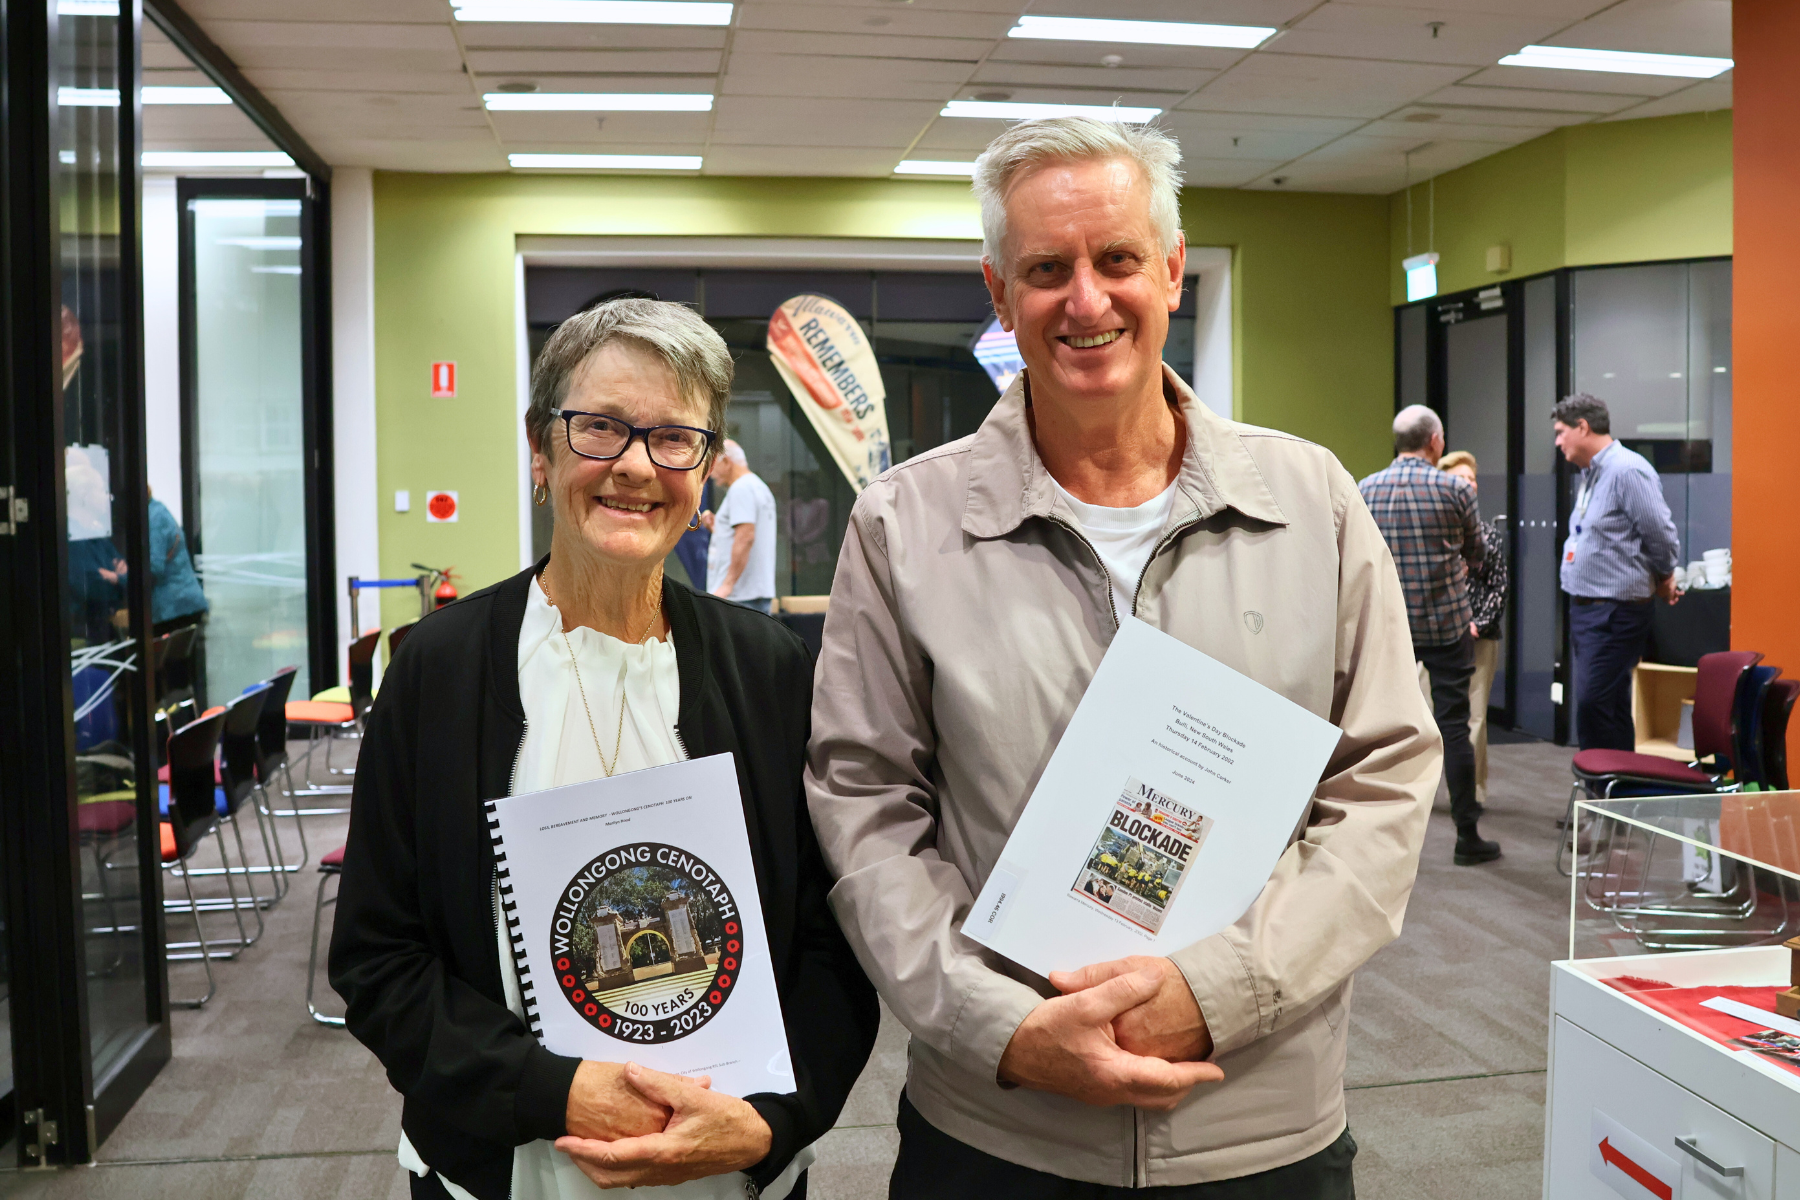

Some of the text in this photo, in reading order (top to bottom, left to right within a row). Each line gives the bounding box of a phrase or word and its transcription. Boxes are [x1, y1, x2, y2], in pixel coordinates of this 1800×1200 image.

[800, 318, 875, 420] REMEMBERS
[1166, 725, 1190, 742] Thursday
[1198, 742, 1221, 758] February
[1172, 705, 1246, 748] The Valentine's Day Blockade
[1190, 726, 1201, 735] New
[1202, 733, 1217, 744] South
[1218, 741, 1233, 753] Wales
[1158, 742, 1180, 756] historical
[1180, 754, 1198, 766] account
[1205, 768, 1216, 776] John
[1137, 784, 1196, 820] MERCURY
[1110, 810, 1193, 862] BLOCKADE
[554, 846, 735, 956] WOLLONGONG CENOTAPH
[613, 1019, 655, 1041] 1923
[670, 1001, 713, 1036] 2023
[624, 987, 695, 1017] 100 YEARS
